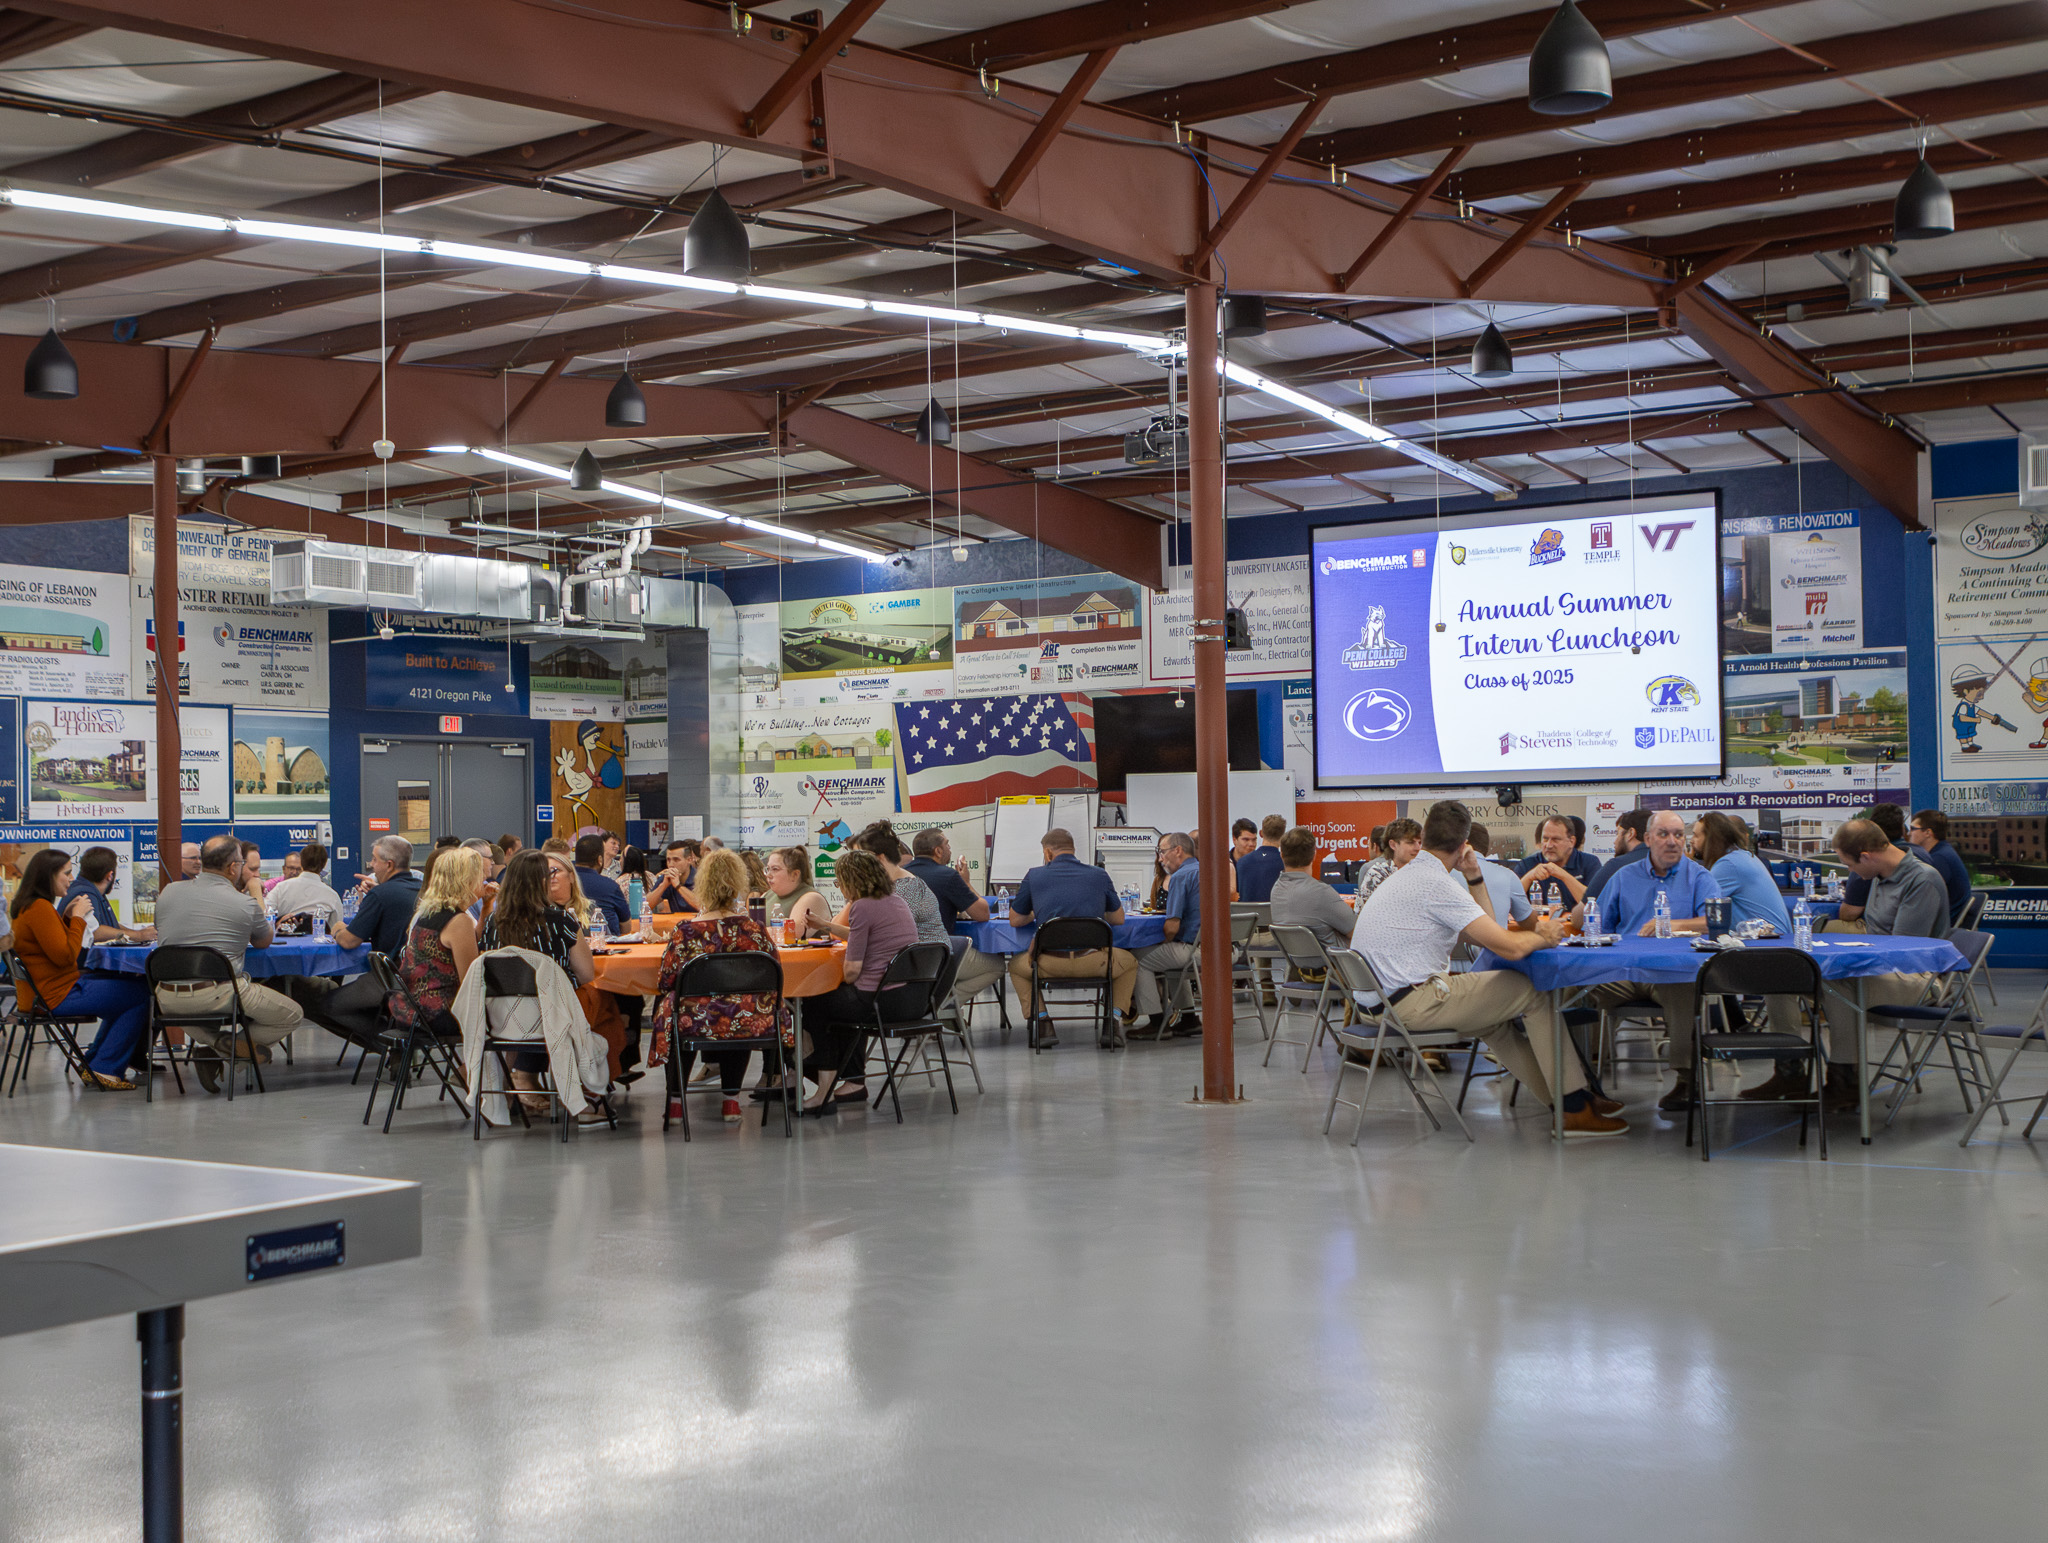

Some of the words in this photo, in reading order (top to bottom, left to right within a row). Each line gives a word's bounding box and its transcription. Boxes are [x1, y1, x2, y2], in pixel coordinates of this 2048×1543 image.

[1766, 518, 1774, 531] &
[1779, 512, 1852, 530] RENOVATION
[1638, 520, 1697, 552] VT
[1966, 524, 2020, 546] Simpson
[231, 536, 244, 548] OF
[1977, 537, 2032, 550] Meadows
[211, 545, 224, 558] OF
[228, 548, 270, 563] GENERAL
[1530, 549, 1563, 565] BUCKNELL
[1584, 550, 1620, 562] TEMPLE
[1337, 555, 1407, 570] BENCHMARK
[1362, 565, 1408, 573] CONSTRUCTION
[1231, 563, 1271, 576] UNIVERSITY
[1959, 566, 2004, 578] Simpson
[1797, 574, 1848, 584] BENCHMARK
[1959, 580, 1968, 590] A
[1971, 576, 2032, 589] Continuing
[29, 582, 44, 593] OF
[46, 583, 97, 597] LEBANON
[971, 586, 999, 595] Cottages
[1036, 579, 1076, 589] Construction
[44, 595, 91, 607] ASSOCIATES
[222, 589, 270, 608] RETAIL
[1152, 596, 1165, 605] USA
[1260, 586, 1292, 599] Designers,
[1947, 590, 2008, 603] Retirement
[814, 602, 834, 616] DUTCH
[835, 601, 852, 613] GOLD
[888, 599, 921, 608] GAMBER
[1458, 595, 1554, 622] Annual
[1558, 592, 1672, 616] Summer
[208, 607, 230, 615] GENERAL
[232, 608, 270, 617] CONSTRUCTION
[271, 610, 292, 618] PROJECT
[739, 612, 765, 620] Enterprise
[1256, 607, 1271, 618] Inc.,
[1272, 604, 1299, 616] General
[1944, 612, 1979, 621] Sponsored
[1994, 609, 2022, 618] Simpson
[2025, 608, 2047, 616] Senior
[239, 627, 313, 643] BENCHMARK
[1169, 627, 1184, 637] MER
[1257, 623, 1270, 632] Inc.,
[1272, 621, 1291, 631] HVAC
[1274, 635, 1309, 645] Contractor
[1458, 633, 1543, 659] Intern
[1547, 626, 1680, 653] Luncheon
[1822, 634, 1855, 643] Mitchell
[238, 642, 273, 650] Construction
[1041, 643, 1060, 658] ABC
[1071, 645, 1105, 655] Completion
[1106, 644, 1117, 652] this
[1118, 643, 1136, 651] Winter
[1163, 656, 1190, 667] Edwards
[1252, 651, 1267, 661] Inc.,
[1268, 649, 1299, 660] Electrical
[1345, 651, 1367, 662] PENN
[1368, 648, 1404, 660] COLLEGE
[406, 653, 433, 668] Built
[436, 656, 449, 669] to
[450, 657, 496, 672] Achieve
[1091, 663, 1139, 674] BENCHMARK
[1351, 659, 1395, 669] WILDCATS
[1726, 664, 1738, 672] H.
[1739, 662, 1768, 672] Arnold
[1770, 660, 1800, 670] Health
[1806, 658, 1850, 669] rofessions
[1853, 656, 1888, 666] Pavilion
[836, 668, 865, 676] WAREHOUSE
[866, 667, 895, 675] EXPANSION
[958, 674, 976, 682] Calvary
[977, 673, 1001, 681] Fellowship
[560, 681, 583, 691] Growth
[852, 678, 889, 686] BENCHMARK
[1464, 673, 1509, 690] Class
[1511, 672, 1529, 691] of
[1532, 668, 1574, 686] 2025
[409, 688, 432, 699] 4121
[435, 689, 470, 702] Oregon
[472, 691, 492, 702] Pike
[1669, 705, 1689, 713] STATE
[53, 706, 97, 727] Landis
[833, 715, 872, 728] Cottages
[66, 720, 114, 735] Homes
[444, 716, 460, 732] EXIT
[1537, 730, 1571, 738] Thaddeus
[1576, 730, 1604, 739] College
[1604, 729, 1612, 738] of
[632, 740, 658, 749] Foxdale
[1519, 735, 1573, 749] Stevens
[1577, 737, 1618, 748] Technology
[1783, 767, 1832, 775] BENCHMARK
[818, 777, 886, 788] BENCHMARK
[1721, 774, 1761, 788] College
[1670, 796, 1734, 808] Expansion
[1737, 795, 1747, 807] &
[1750, 793, 1824, 806] Renovation
[1827, 792, 1874, 806] Project
[1942, 787, 1989, 800] COMING
[57, 804, 91, 817] Hybrid
[92, 804, 125, 817] Homes
[198, 805, 220, 814] Bank
[1495, 803, 1559, 818] CORNERS
[1943, 802, 1986, 813] EPHRATA
[740, 826, 755, 834] 2017
[891, 821, 953, 831] ECONSTRUCTION
[1327, 822, 1356, 832] Soon:
[60, 828, 125, 840] RENOVATION
[1315, 836, 1357, 851] Urgent
